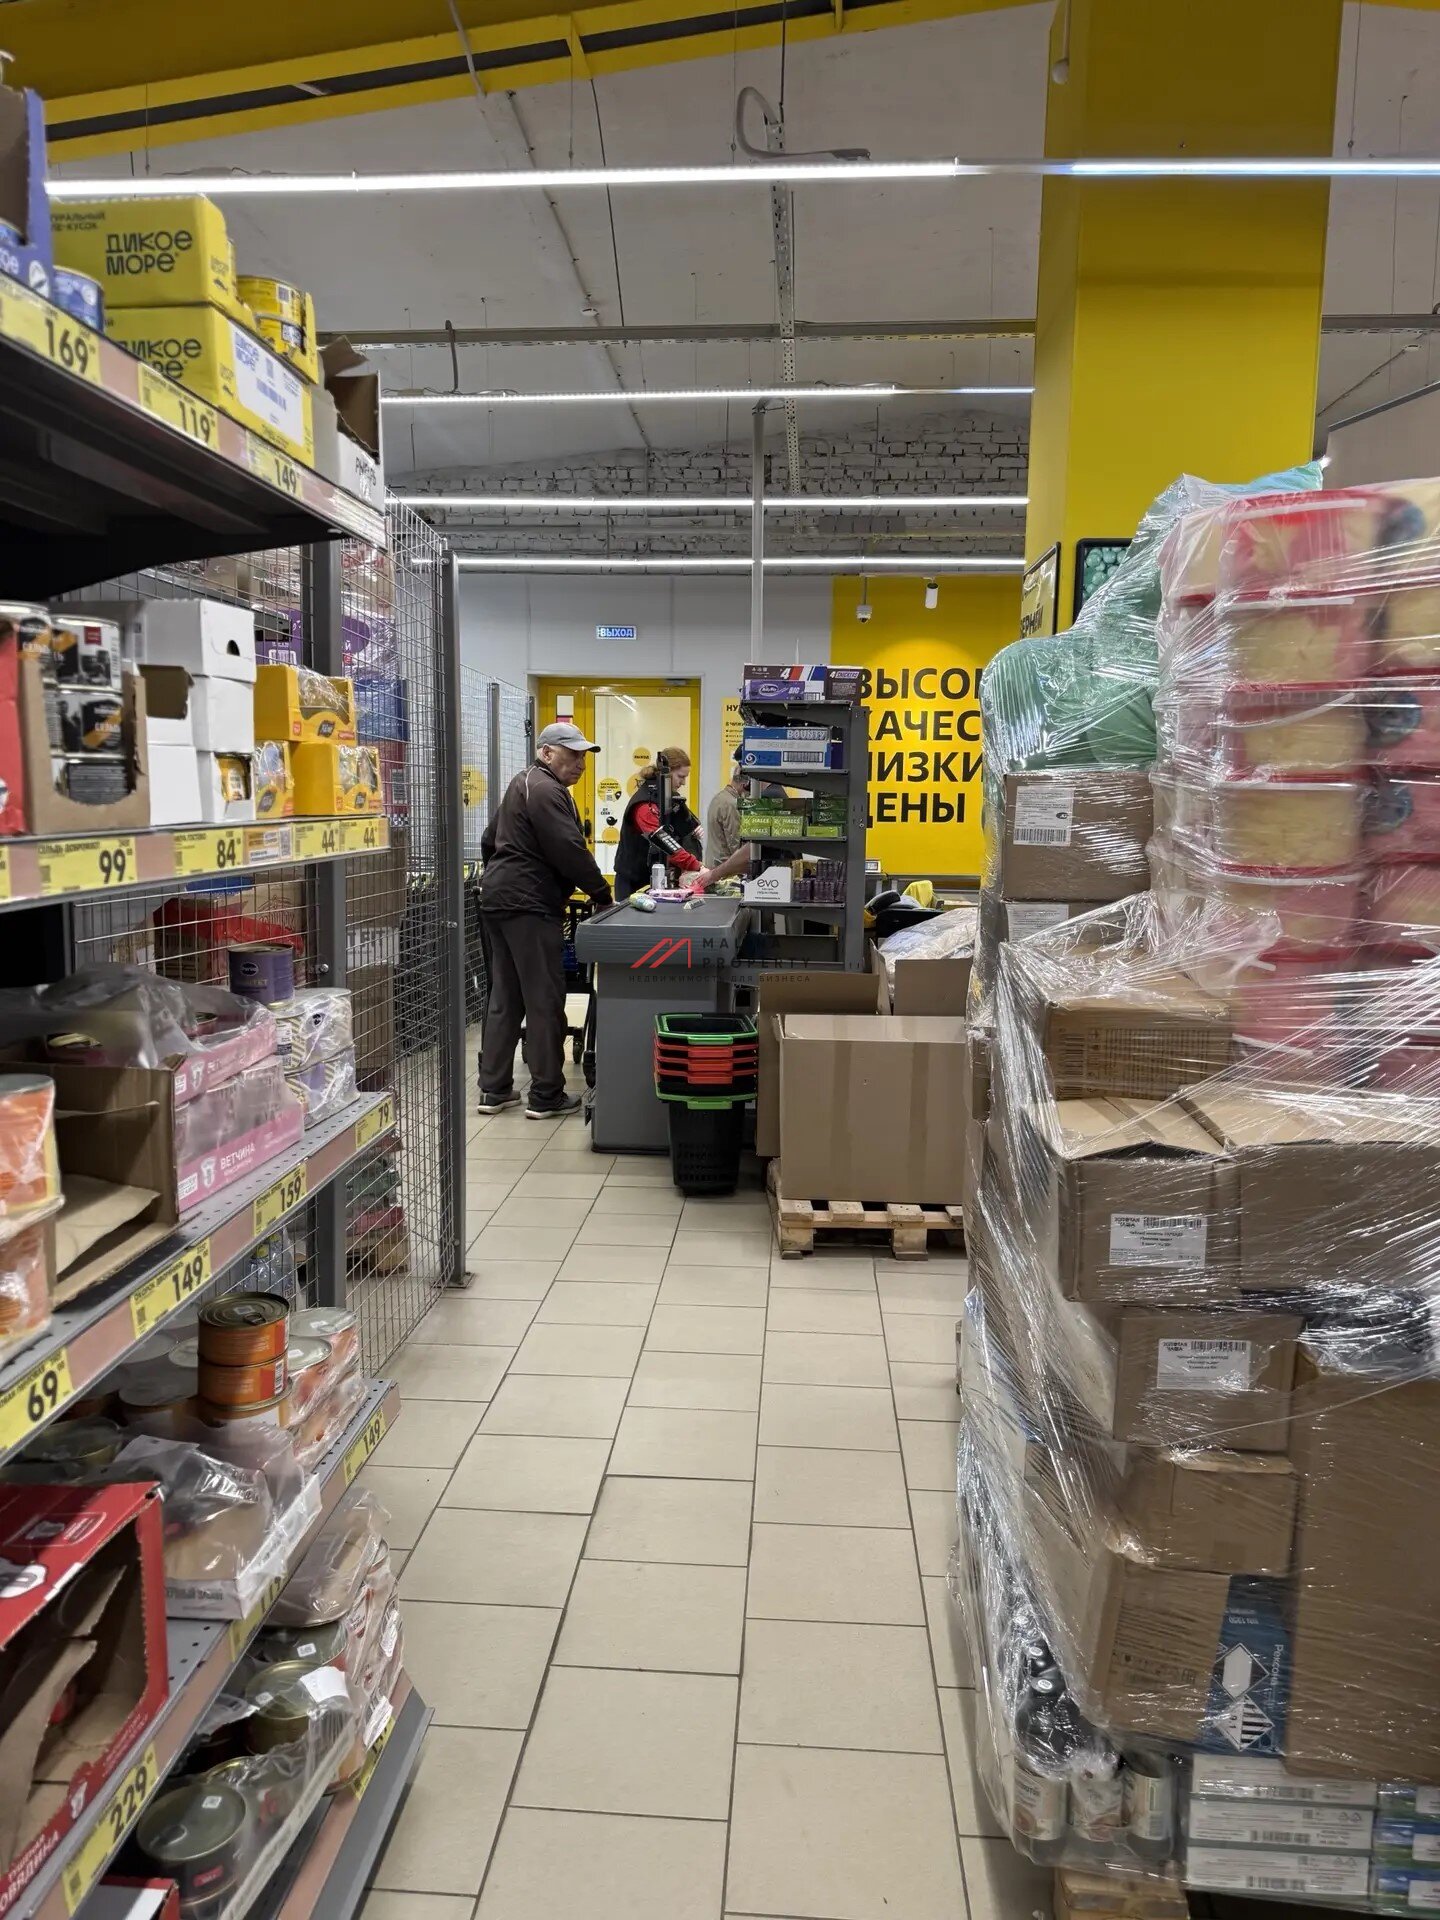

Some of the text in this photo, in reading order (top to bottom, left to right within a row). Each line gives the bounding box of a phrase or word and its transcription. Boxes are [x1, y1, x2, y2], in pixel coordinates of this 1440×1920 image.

[45, 318, 89, 375] 169
[178, 401, 211, 447] 119
[274, 458, 297, 496] 149
[600, 627, 633, 637] ВЫХОД
[726, 704, 740, 712] НУ
[786, 729, 828, 740] BOUNTY
[868, 709, 980, 742] АЧЕС
[217, 839, 236, 869] 84
[321, 829, 335, 853] 44
[363, 827, 375, 849] 44
[99, 849, 126, 884] 99
[757, 878, 779, 888] evo
[378, 1102, 389, 1128] 79
[220, 1142, 256, 1170] ВЕТЧИНА
[280, 1175, 302, 1213] 159
[172, 1254, 204, 1302] 149
[28, 1369, 58, 1423] 69
[363, 1418, 381, 1455] 149
[1270, 1642, 1285, 1686] Рексона
[109, 1765, 148, 1844] 229
